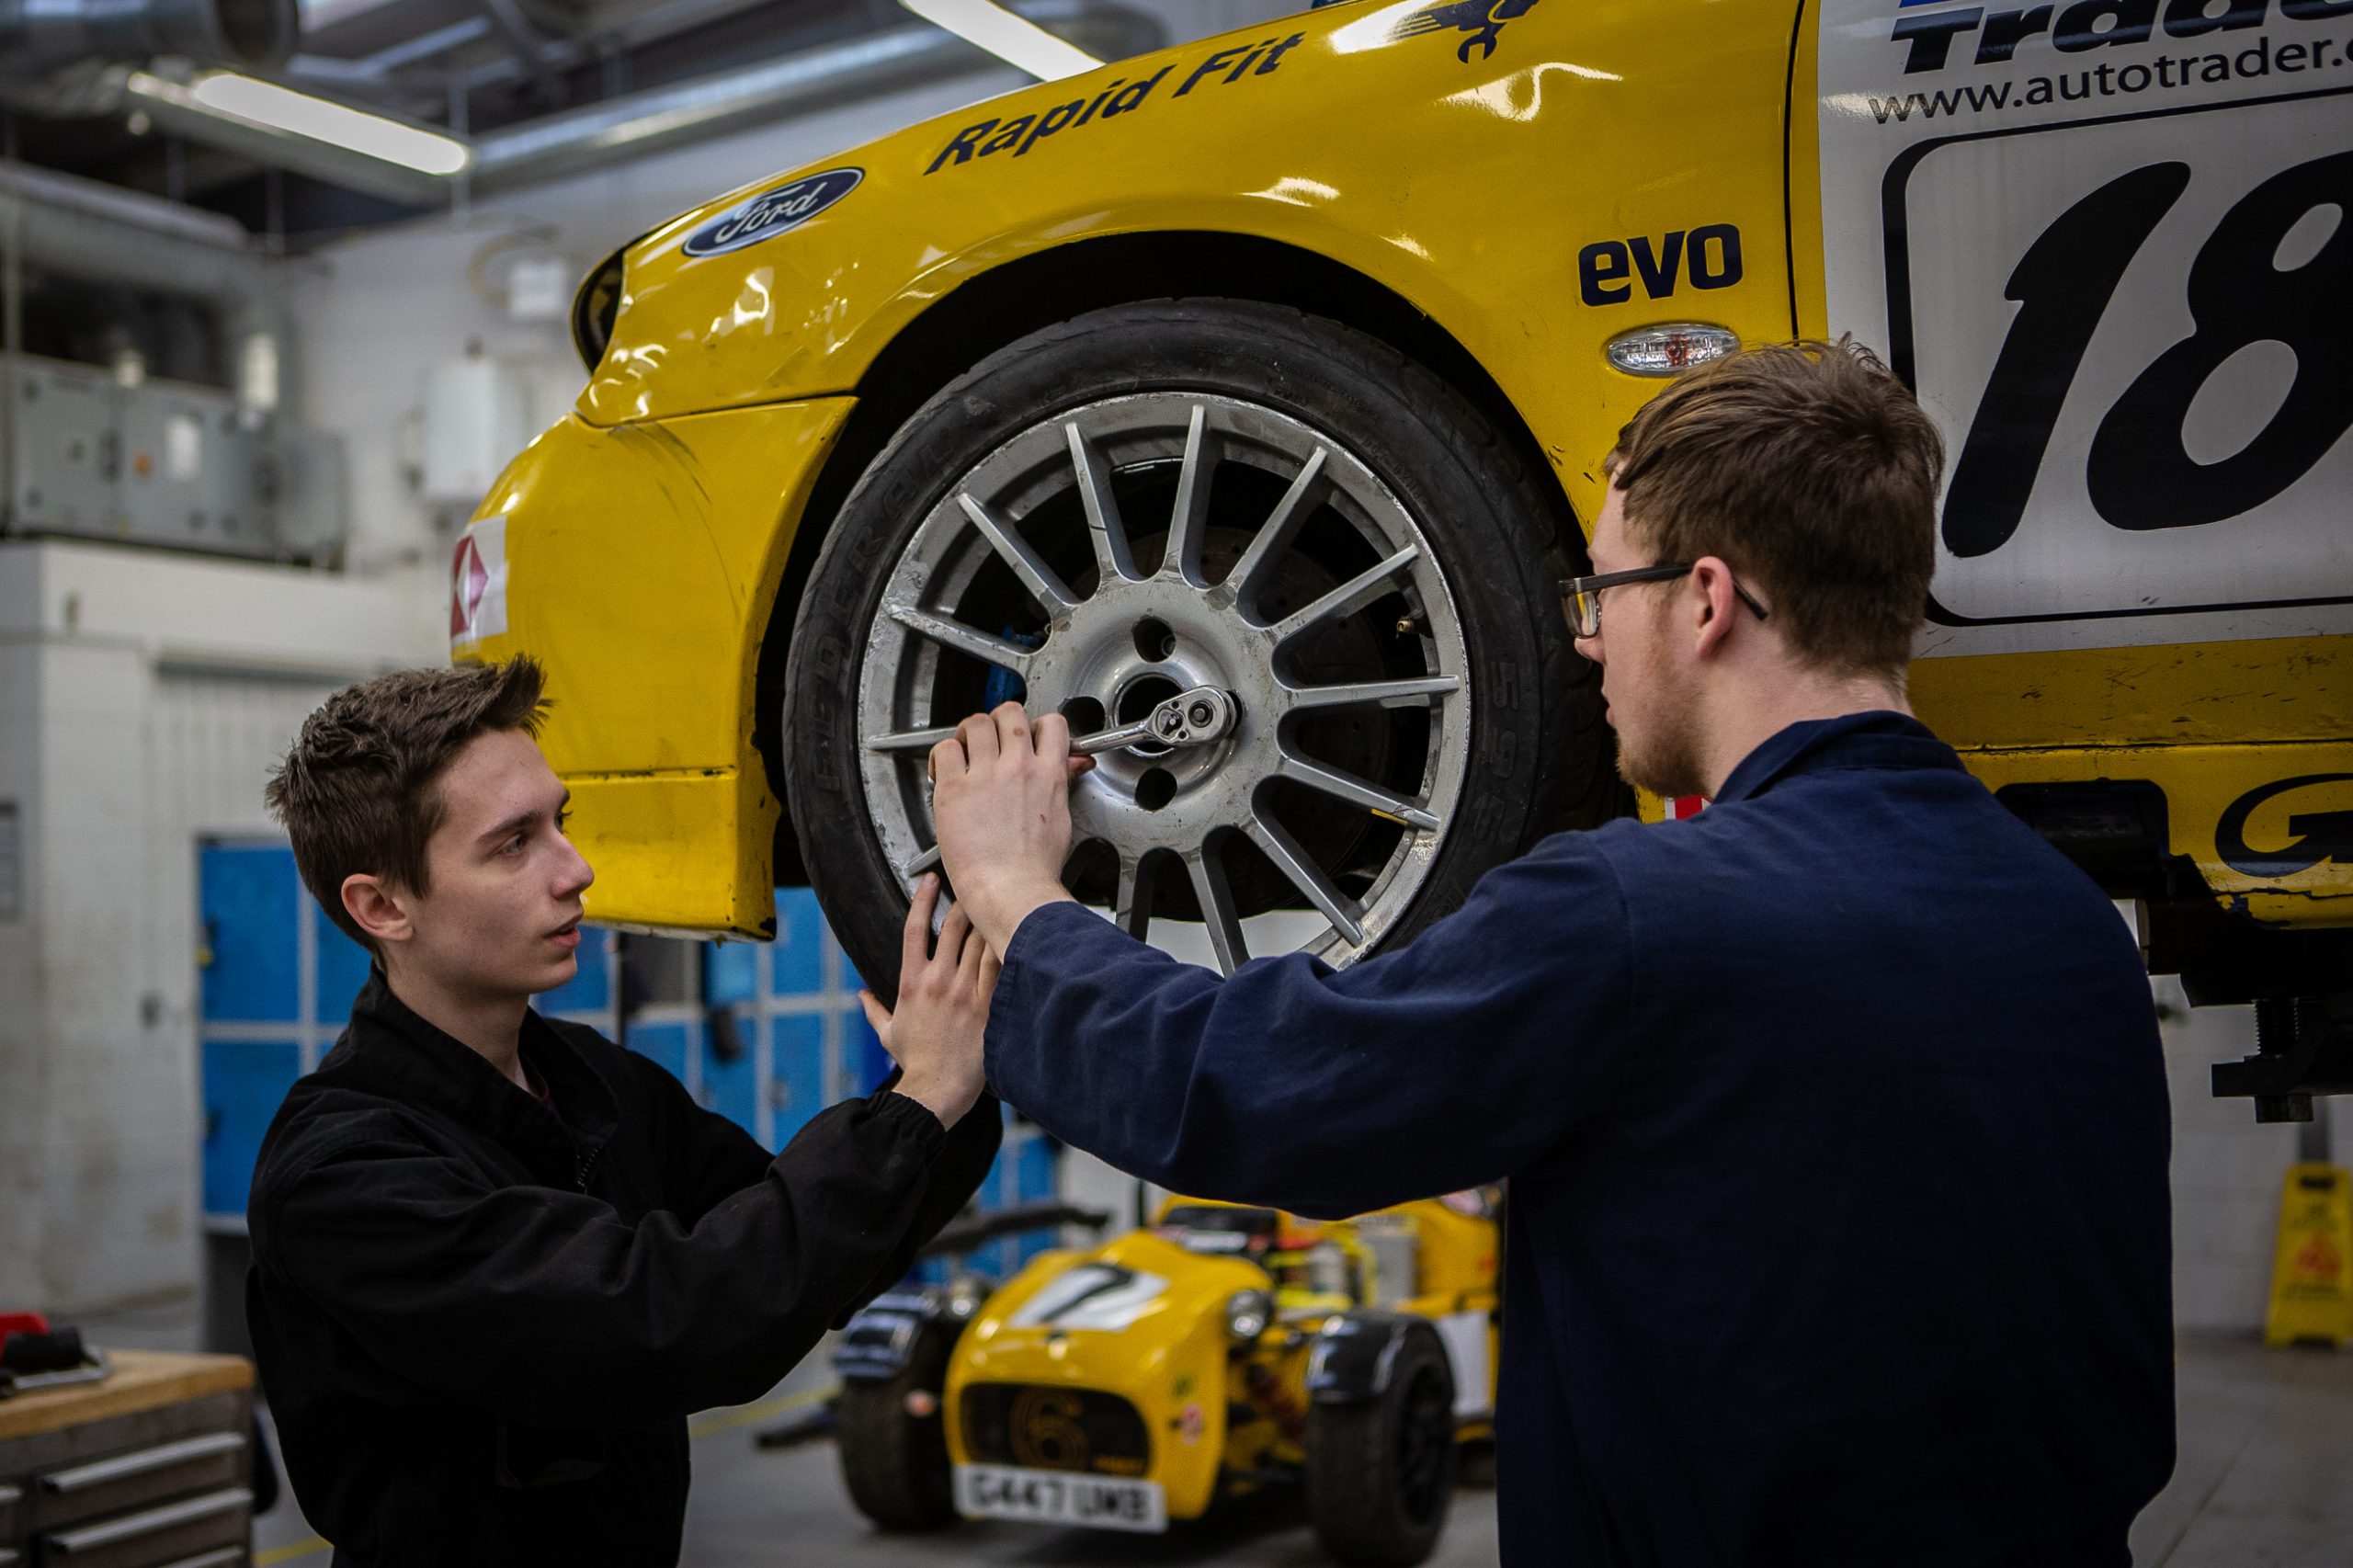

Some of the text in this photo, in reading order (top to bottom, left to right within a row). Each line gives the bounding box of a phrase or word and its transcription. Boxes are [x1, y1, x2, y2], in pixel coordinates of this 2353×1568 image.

[923, 31, 1306, 176] Rapid Fit
[1869, 36, 2353, 124] www.autotrader.
[714, 182, 828, 244] Ford
[1578, 223, 1744, 307] evo
[1941, 152, 2353, 557] 18
